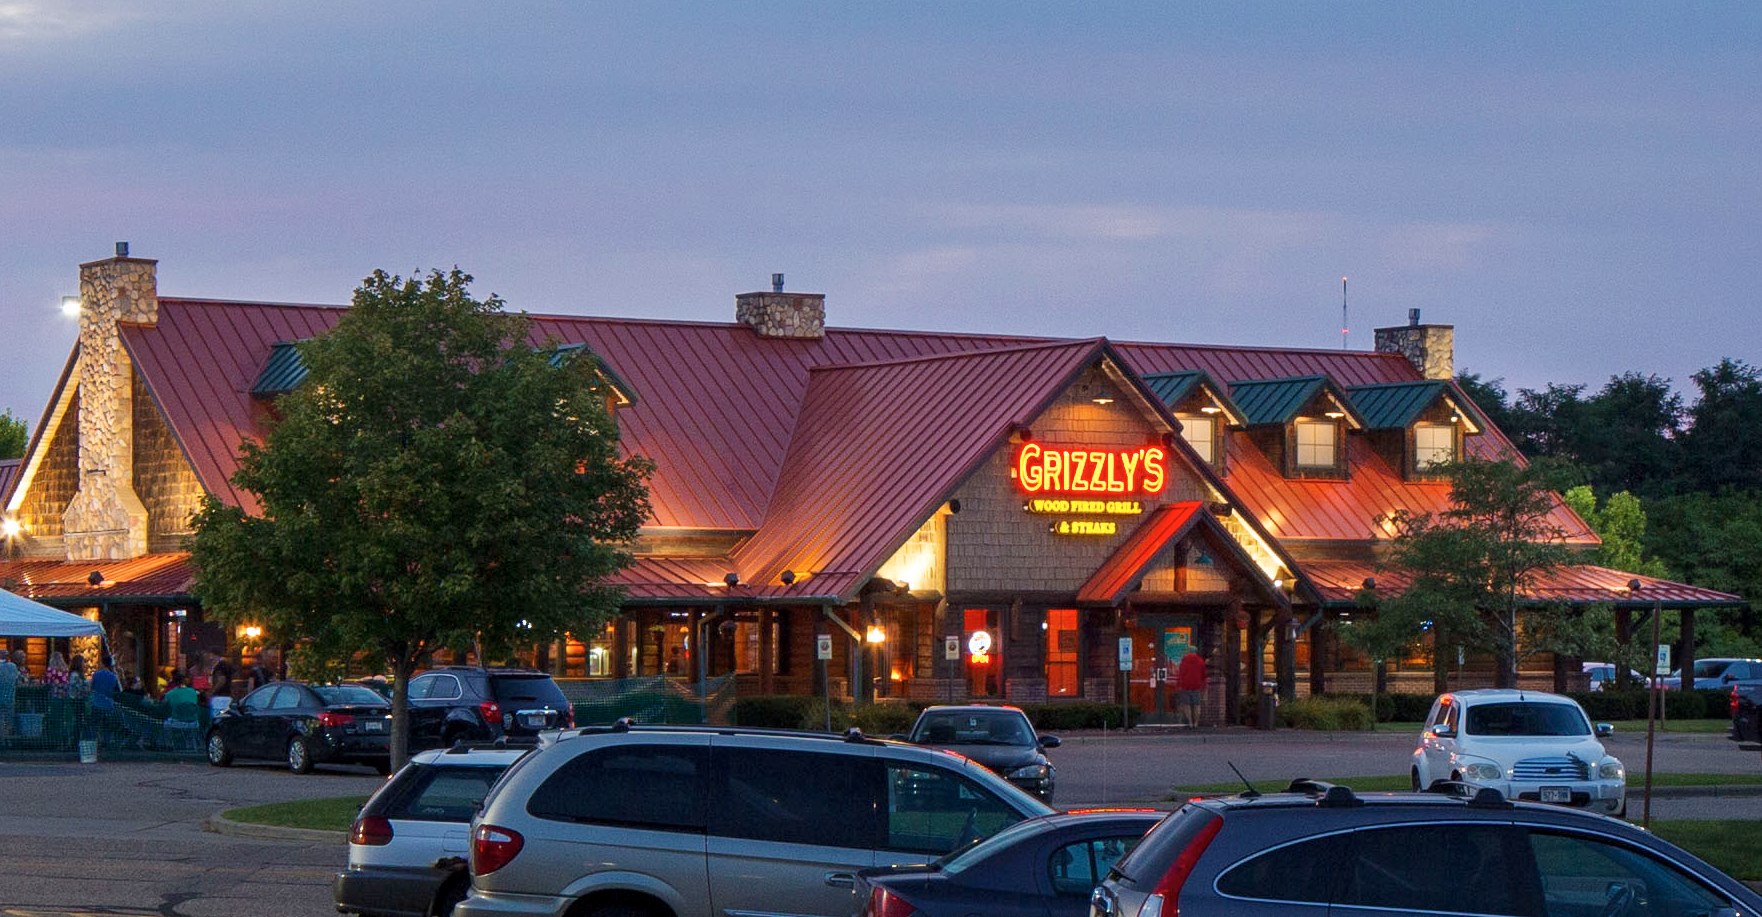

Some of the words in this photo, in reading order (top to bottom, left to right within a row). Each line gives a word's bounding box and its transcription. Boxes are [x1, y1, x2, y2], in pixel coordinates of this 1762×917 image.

[1019, 443, 1164, 493] GRIZZLY'S
[1034, 499, 1070, 512] WOOD
[1070, 500, 1105, 513] FIRED
[1106, 501, 1142, 514] GRILL
[1059, 521, 1069, 534] &
[1071, 521, 1116, 534] STEAKS
